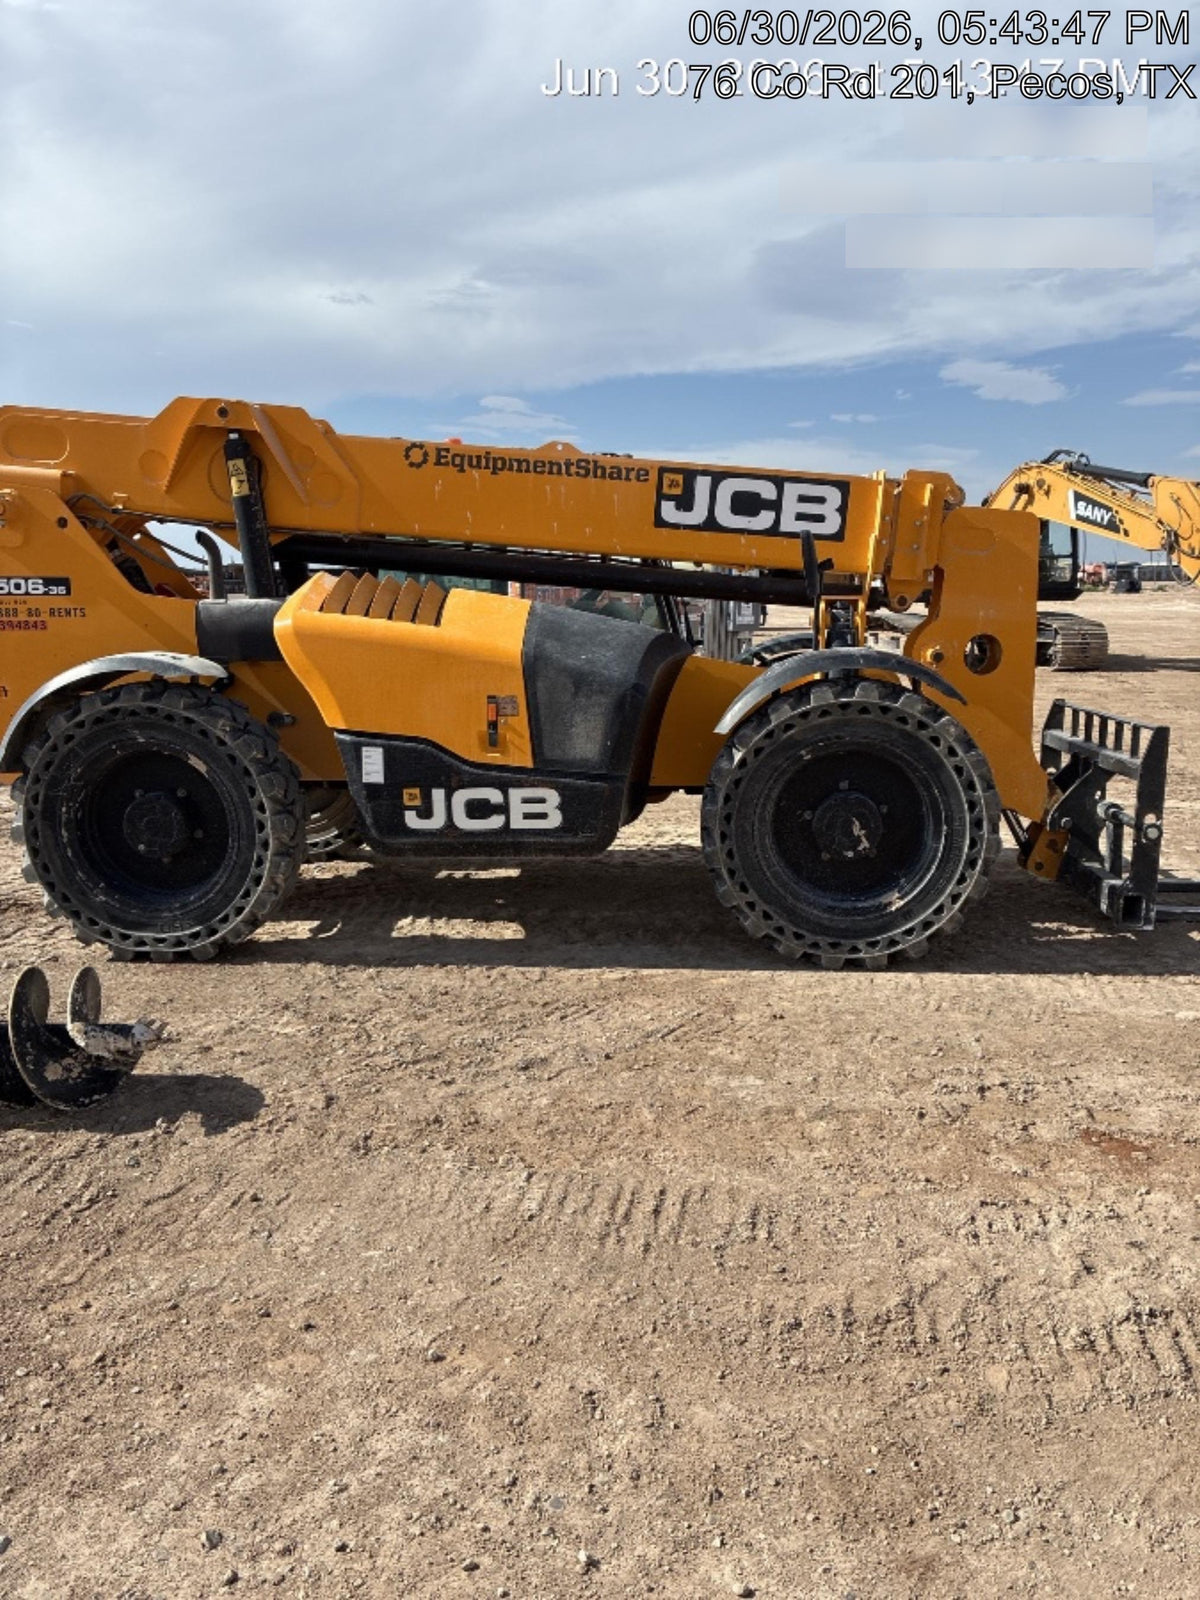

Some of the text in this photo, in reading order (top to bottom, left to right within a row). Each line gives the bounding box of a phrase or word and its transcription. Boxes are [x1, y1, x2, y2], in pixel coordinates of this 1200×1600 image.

[433, 447, 650, 483] EquipmentShare
[660, 475, 842, 535] JCB
[1076, 501, 1113, 525] SANY
[404, 787, 563, 830] JCB
